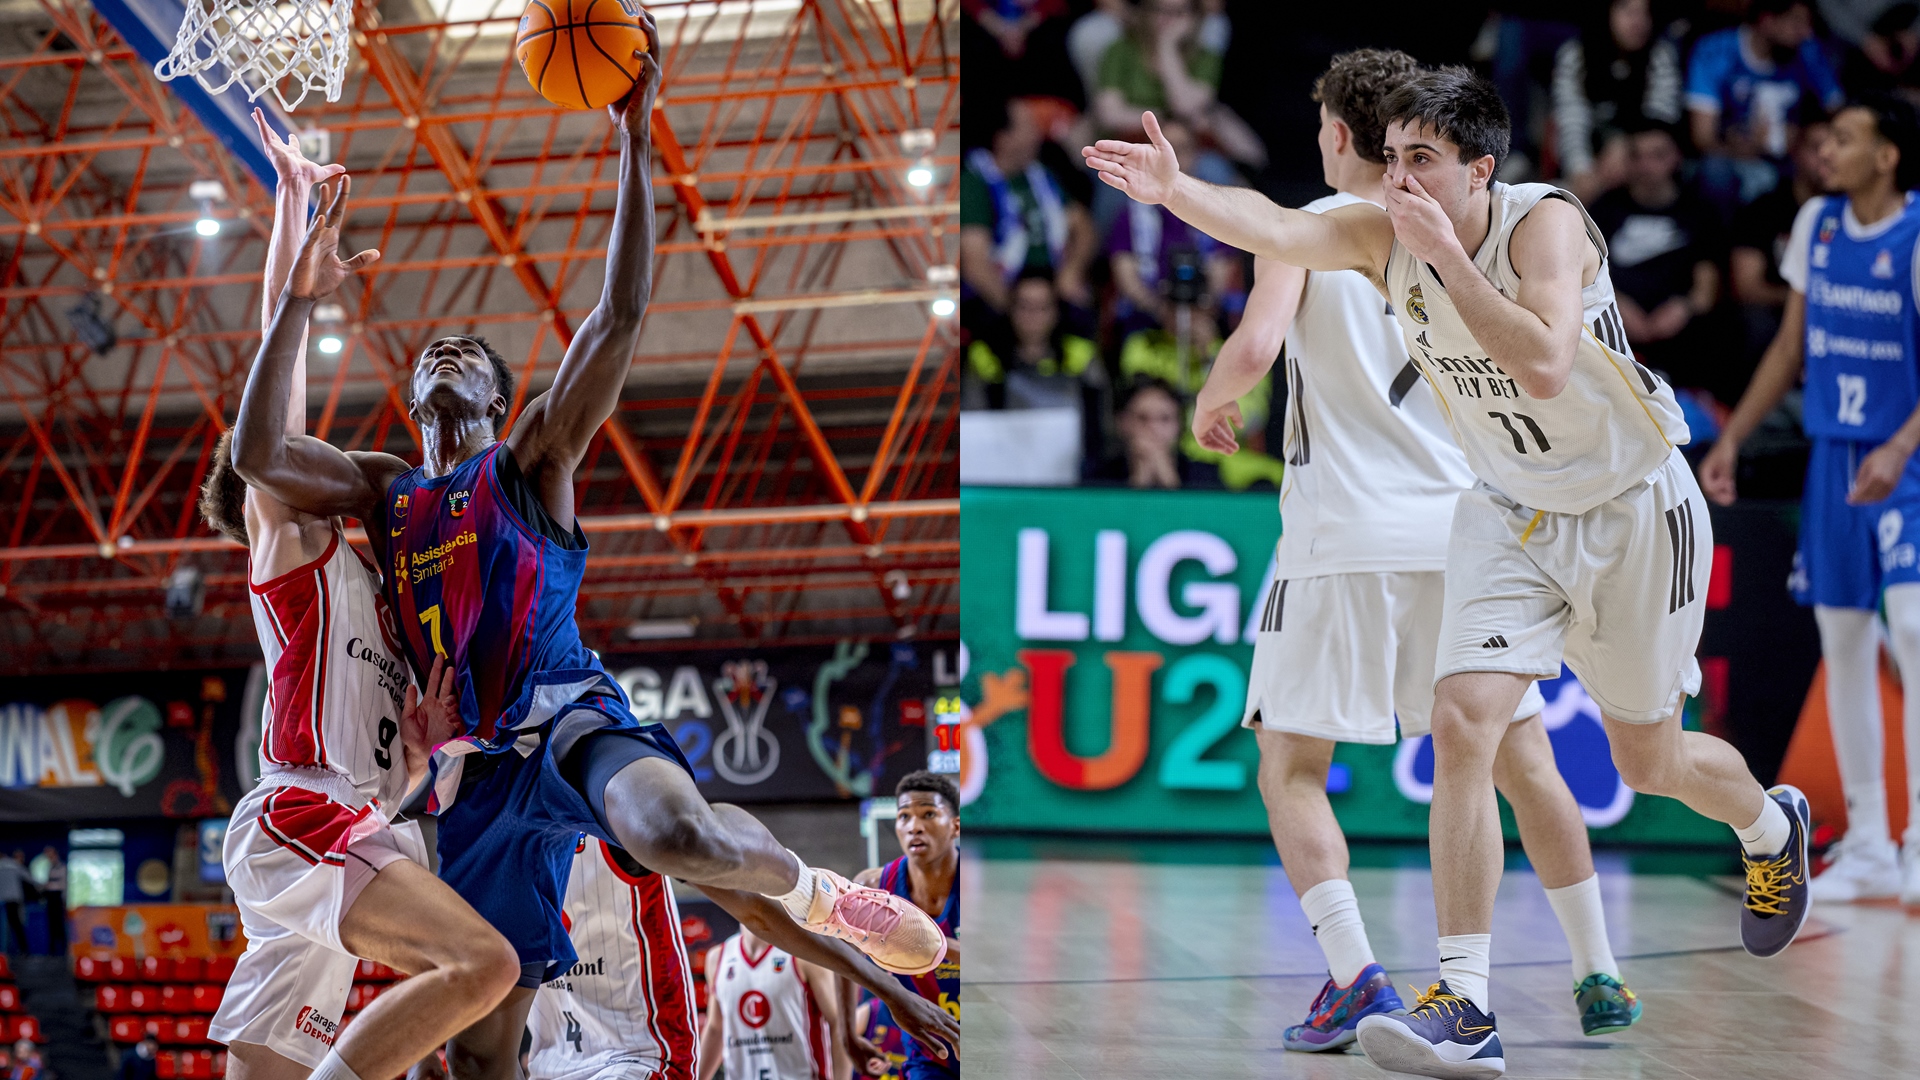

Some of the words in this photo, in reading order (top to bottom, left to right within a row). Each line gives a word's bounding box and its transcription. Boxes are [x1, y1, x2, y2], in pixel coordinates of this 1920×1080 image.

[1453, 375, 1481, 398] FLY
[1486, 377, 1519, 399] BET
[1837, 373, 1867, 426] 12
[1487, 411, 1551, 454] 11
[448, 490, 469, 501] LIGA
[412, 554, 455, 585] Sanitàra
[419, 604, 449, 660] 7
[615, 667, 713, 720] GA
[374, 716, 397, 771] 9
[1017, 649, 1247, 791] U2
[0, 703, 97, 786] NAL
[303, 1021, 334, 1046] DEPOR
[309, 1009, 338, 1033] Zarago
